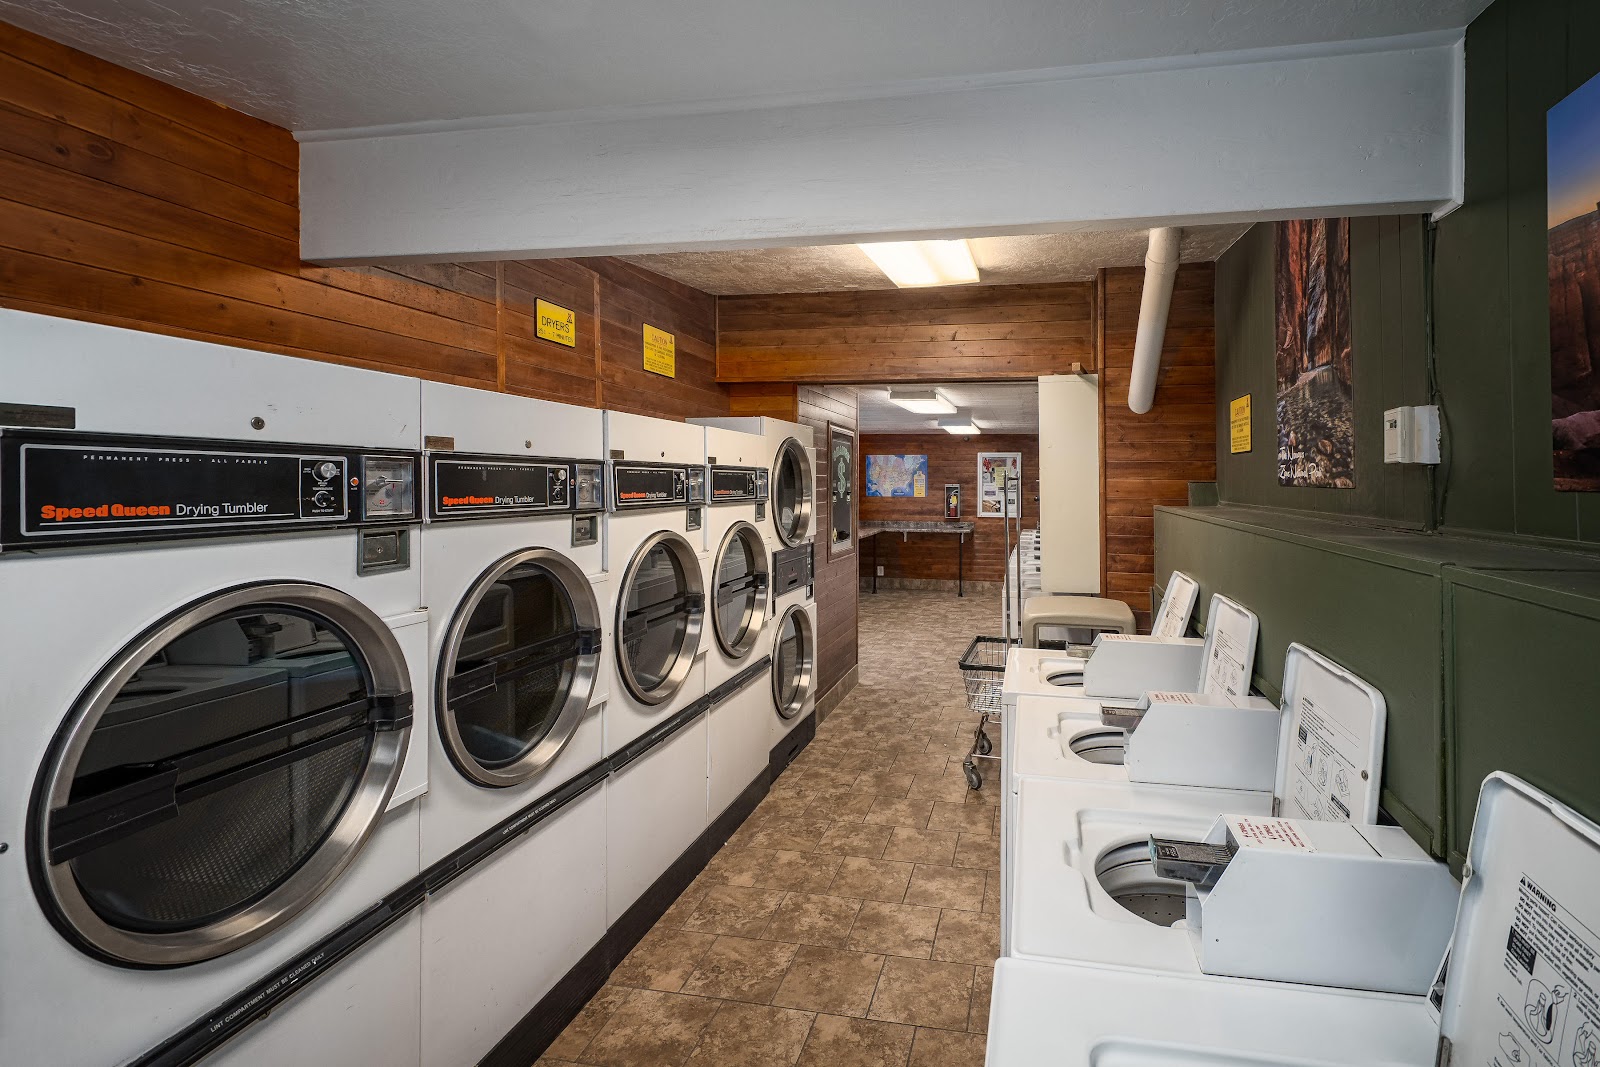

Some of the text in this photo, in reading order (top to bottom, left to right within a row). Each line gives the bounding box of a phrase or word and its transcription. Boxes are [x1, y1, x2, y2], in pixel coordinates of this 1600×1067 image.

[542, 316, 570, 333] DRYERS
[40, 502, 268, 521] Speed Queen Drying Tumbler
[442, 496, 468, 506] Speed
[469, 496, 494, 504] Queen
[495, 496, 514, 505] Drying
[1527, 881, 1556, 912] WARNING
[1558, 924, 1568, 935] cause
[1569, 934, 1582, 948] serious
[1554, 930, 1566, 941] washer
[1580, 953, 1593, 968] moving
[210, 1020, 224, 1033] LINT
[225, 992, 265, 1023] COMPARTMENT
[266, 982, 281, 994] MUST
[289, 961, 312, 979] CLEANED
[311, 952, 325, 965] DAILY
